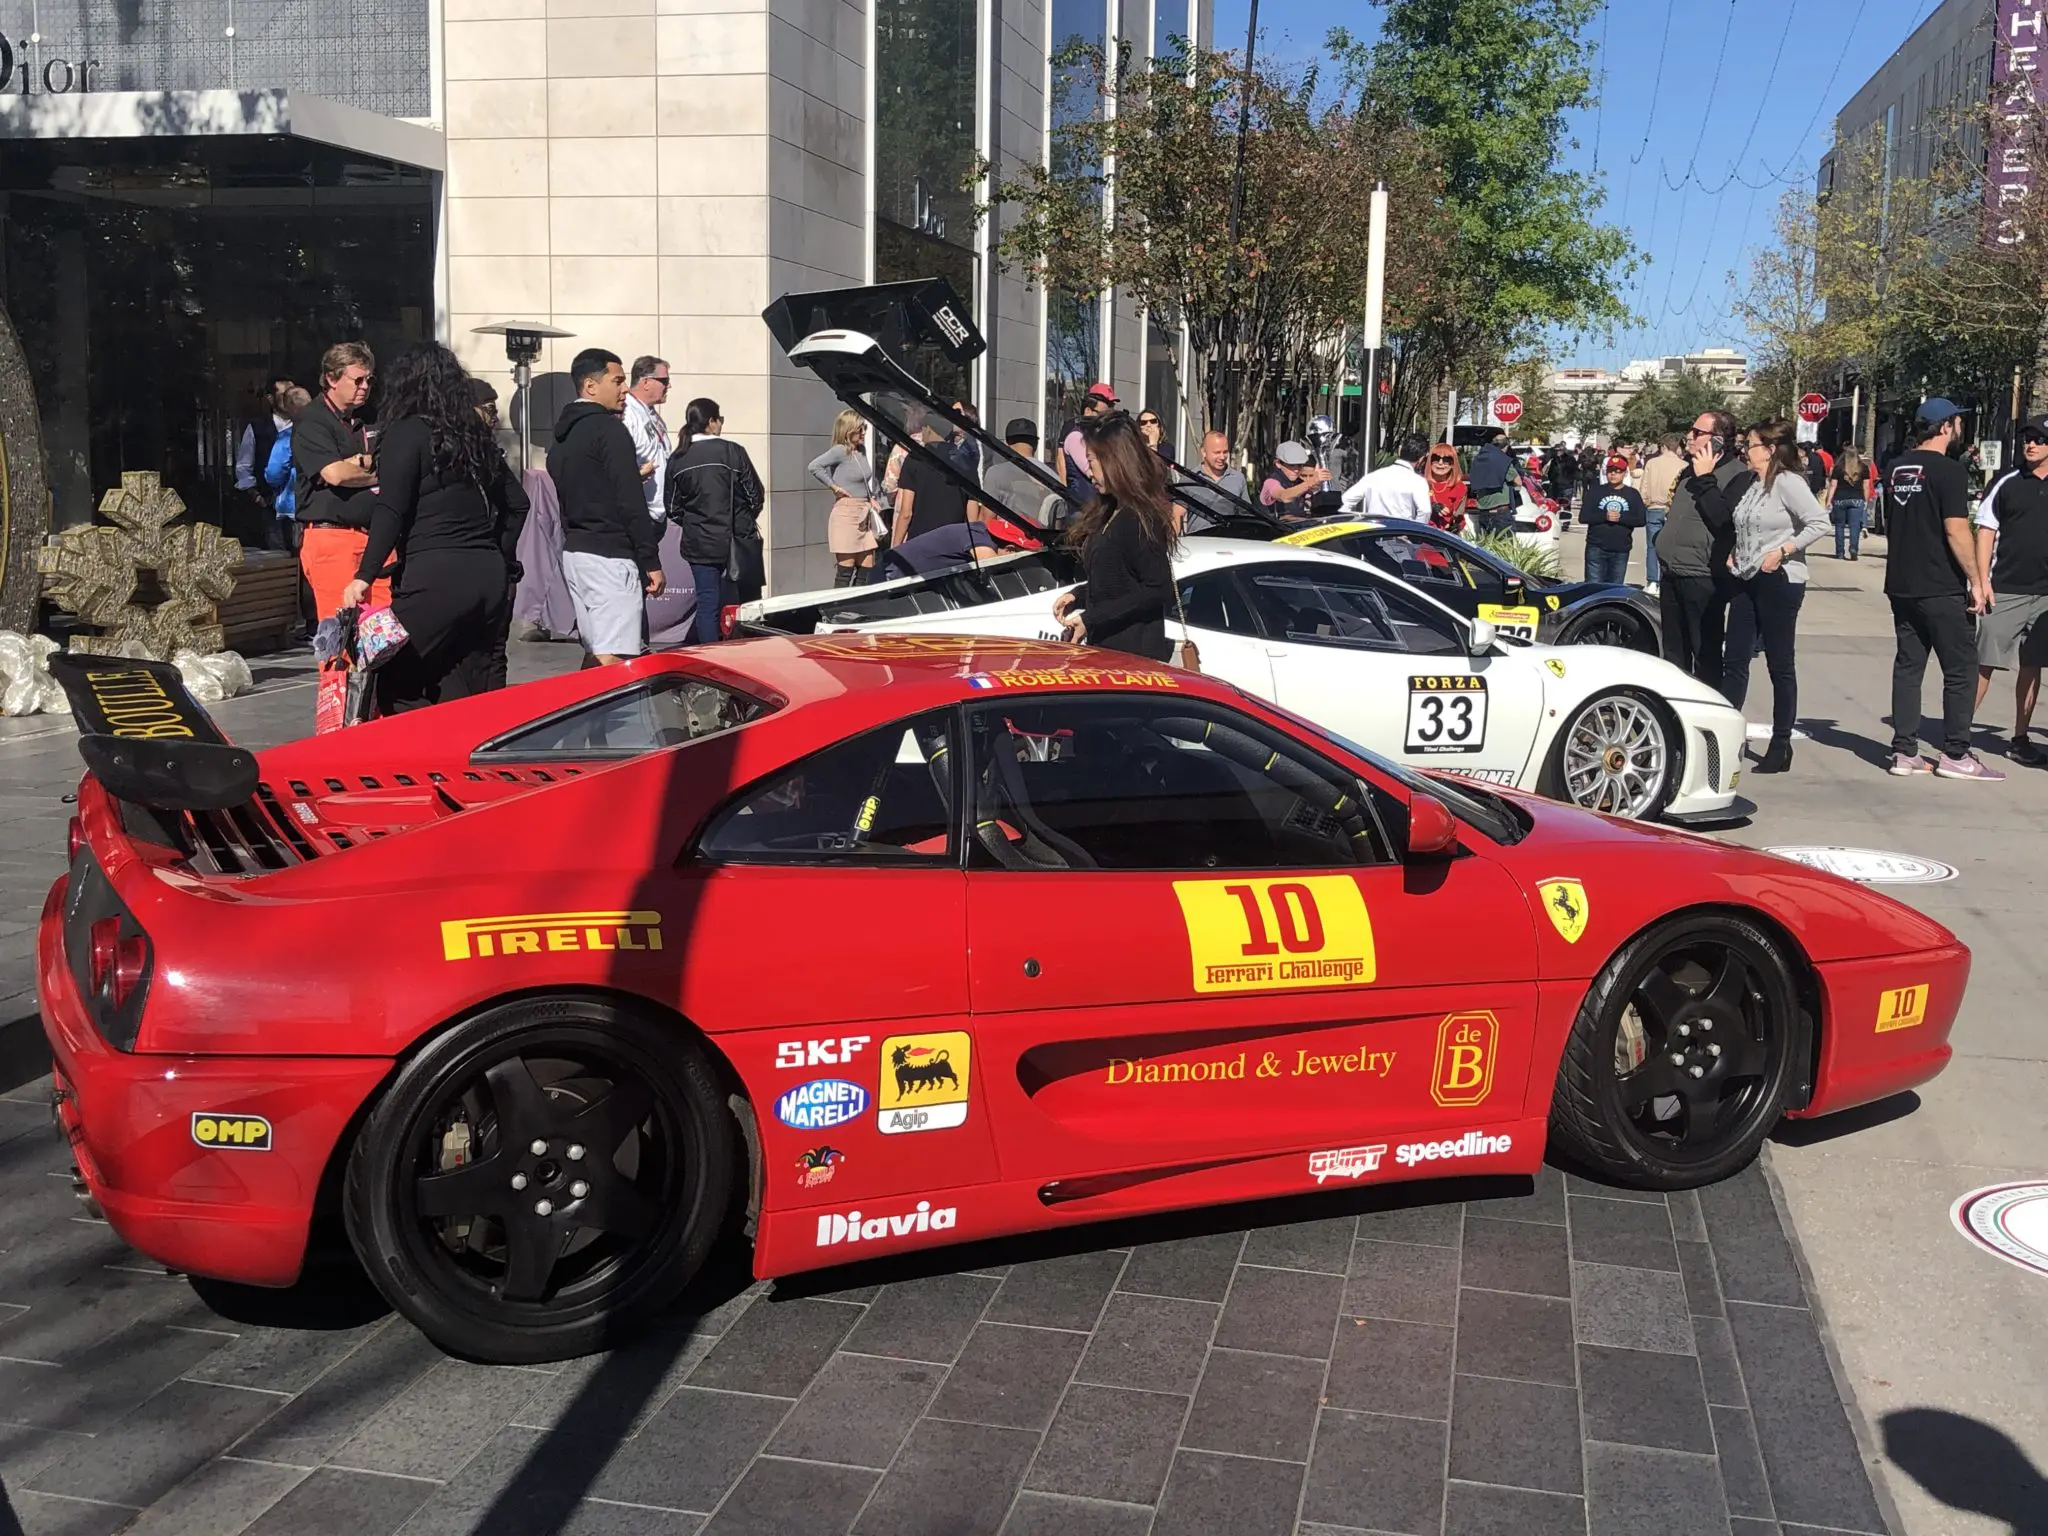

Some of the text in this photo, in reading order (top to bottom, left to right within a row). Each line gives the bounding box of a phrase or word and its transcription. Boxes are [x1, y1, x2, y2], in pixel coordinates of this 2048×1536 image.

[1998, 0, 2042, 244] HEATERS
[939, 306, 970, 341] CCR
[1495, 402, 1520, 414] STOP
[1800, 402, 1827, 414] STOP
[1000, 674, 1179, 688] ROBERT LAVIE
[1413, 677, 1480, 689] FORZA
[87, 670, 194, 739] BOULLE
[1417, 695, 1473, 742] 33
[858, 797, 876, 829] OMP
[1224, 883, 1325, 956] 10
[440, 911, 663, 961] PIRELLI
[1205, 957, 1364, 984] Ferrari Challenge
[1891, 989, 1916, 1019] 10
[1455, 1024, 1482, 1043] de
[775, 1035, 871, 1068] SKF
[1105, 1046, 1397, 1084] Diamond & Jewelry
[1443, 1045, 1483, 1089] B
[781, 1081, 864, 1108] MAGNETI
[781, 1101, 864, 1127] MARELLI
[890, 1109, 929, 1130] Agip
[195, 1118, 267, 1143] OMP
[1395, 1131, 1512, 1167] speedline
[816, 1200, 957, 1247] Diavia
